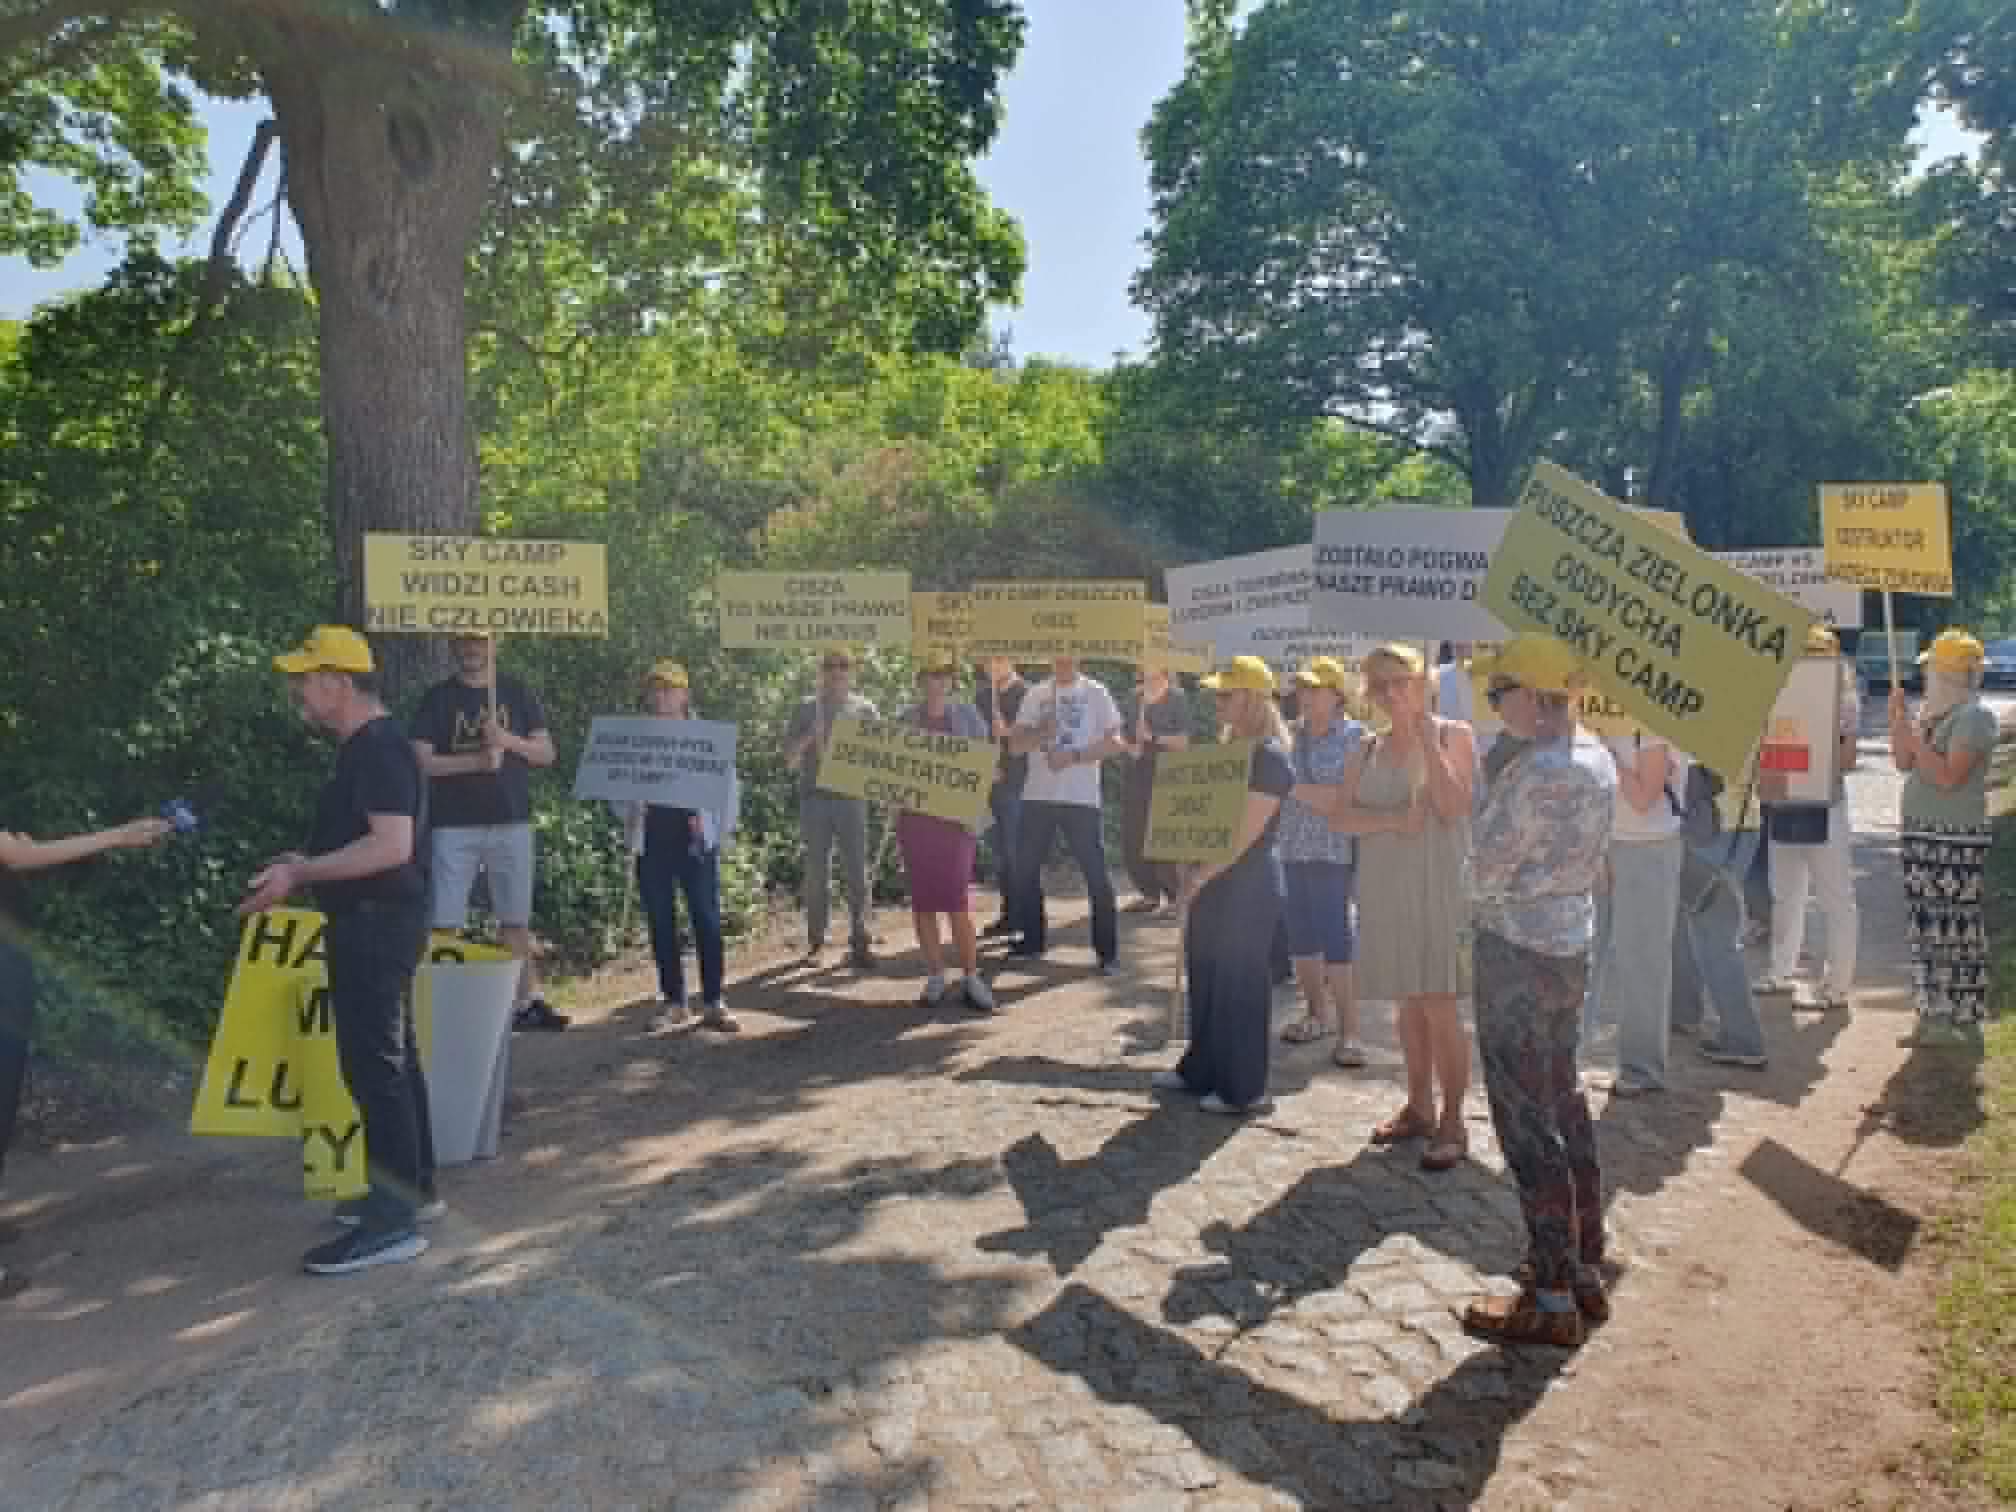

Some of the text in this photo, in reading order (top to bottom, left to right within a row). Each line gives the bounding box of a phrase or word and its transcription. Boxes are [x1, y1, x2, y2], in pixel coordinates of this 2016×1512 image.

[408, 537, 568, 566] SKY CAMP
[400, 570, 581, 599] WIDZI CASH
[1314, 573, 1373, 595] NASZE
[1380, 577, 1456, 600] PRAWO
[1523, 478, 1787, 664] PUSZCZA ZIELONKA
[368, 604, 608, 629] NIE CZŁOWIEKA
[1553, 552, 1682, 659] ODDYCHA
[1509, 570, 1705, 717] BEZ SKY CAMP
[857, 718, 971, 756] SKY CAMP
